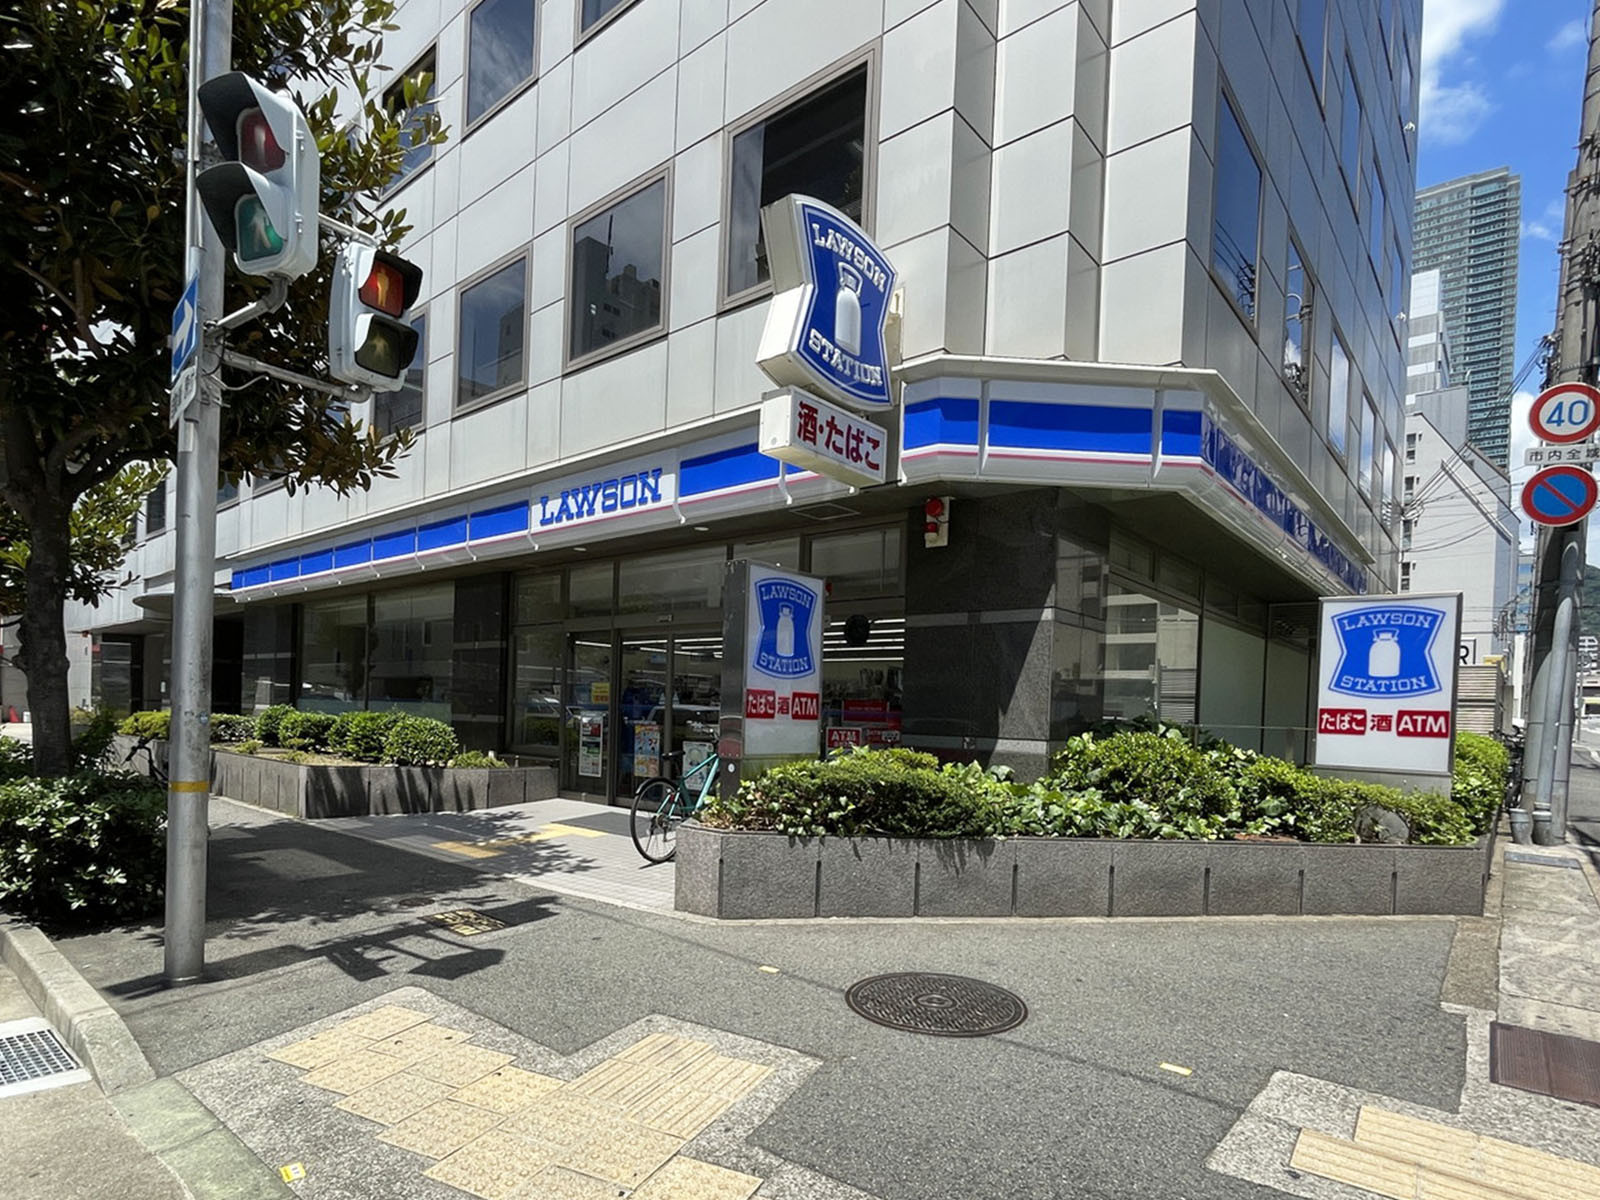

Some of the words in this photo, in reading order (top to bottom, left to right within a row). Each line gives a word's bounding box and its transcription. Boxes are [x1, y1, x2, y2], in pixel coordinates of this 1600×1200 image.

[811, 223, 887, 293] LAWSON
[809, 327, 883, 386] STATION
[1546, 399, 1590, 427] 40
[539, 467, 663, 526] LAWSON
[761, 585, 812, 608] LAWSON
[1342, 612, 1434, 631] LAWSON
[759, 651, 808, 673] STATION
[1340, 675, 1428, 692] STATION
[747, 694, 775, 715] たばこ
[777, 696, 790, 715] 酒
[792, 697, 818, 716] ATM
[1320, 711, 1365, 731] たばこ
[1370, 714, 1393, 732] 酒
[1398, 715, 1446, 733] ATM
[831, 730, 857, 742] ATM
